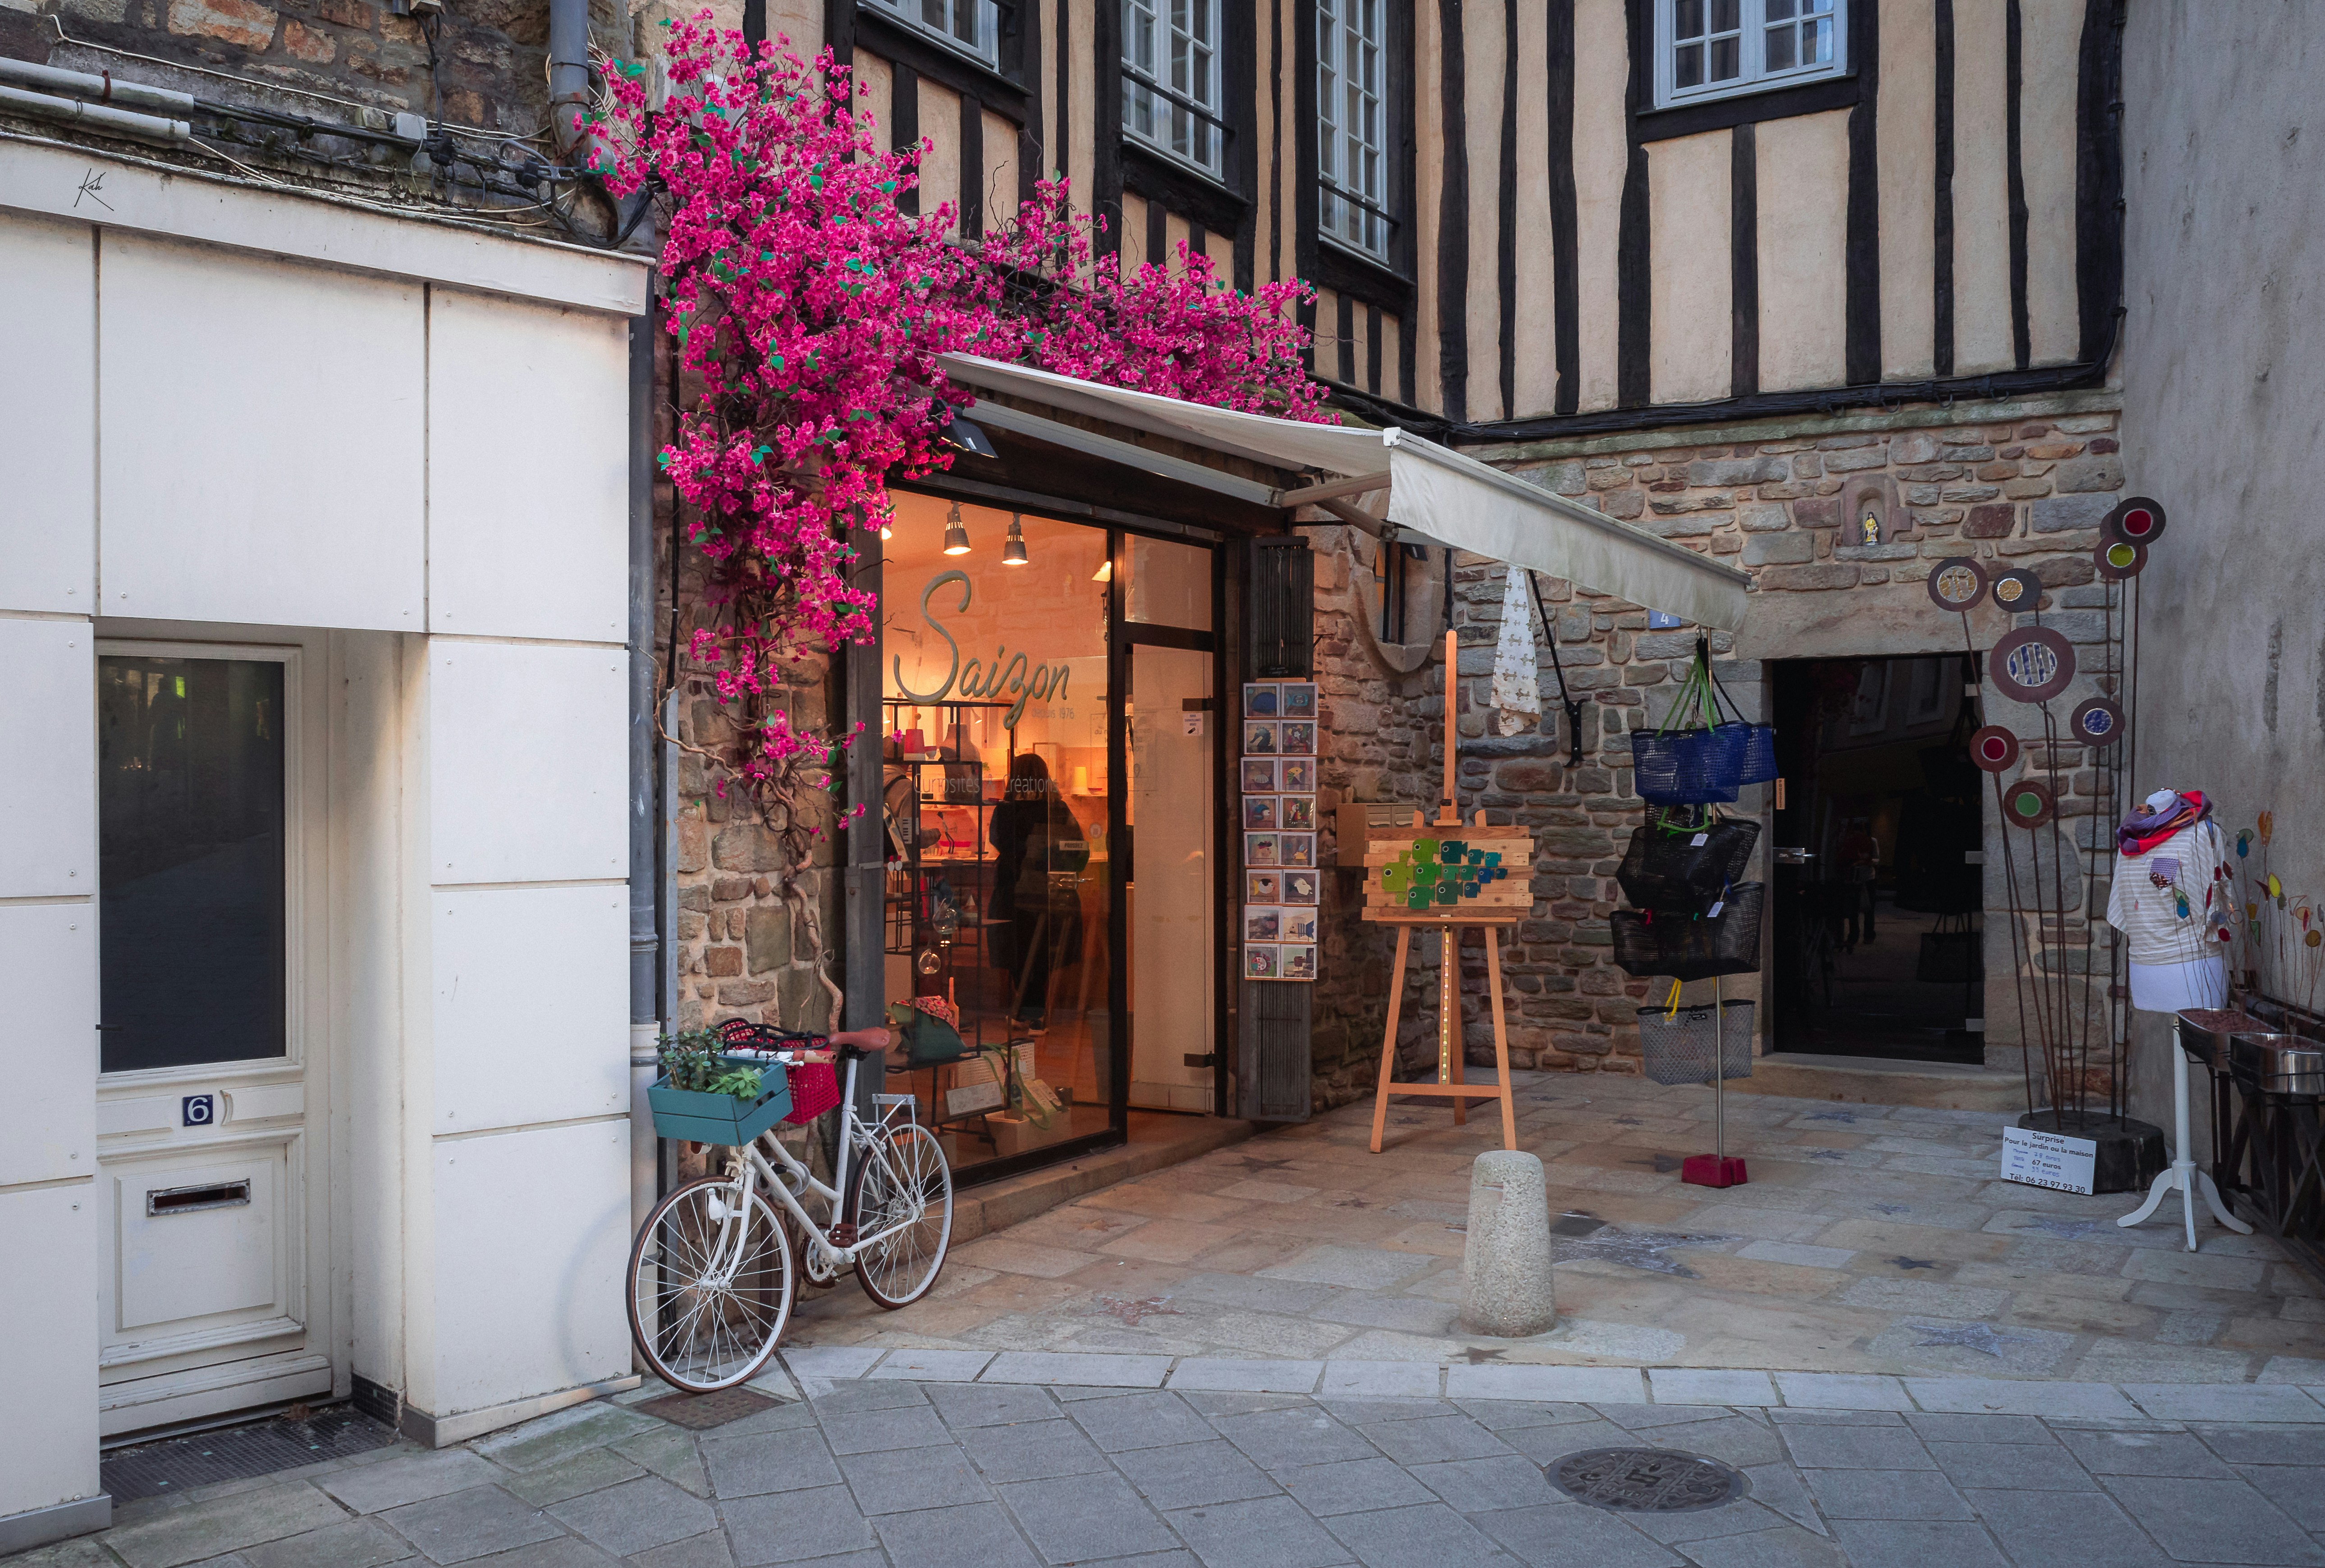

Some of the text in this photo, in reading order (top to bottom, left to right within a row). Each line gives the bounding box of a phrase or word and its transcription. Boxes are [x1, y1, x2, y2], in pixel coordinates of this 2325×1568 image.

[1661, 613, 1669, 625] 4
[893, 570, 1070, 730] Saizon
[1059, 707, 1075, 719] 1976
[914, 773, 980, 793] Curiosités
[1003, 773, 1058, 793] Créations
[188, 1097, 209, 1122] 6
[2032, 1133, 2064, 1144] Surprise
[2029, 1142, 2049, 1150] jardin
[2069, 1150, 2093, 1158] maison
[2009, 1173, 2023, 1181] Tél:
